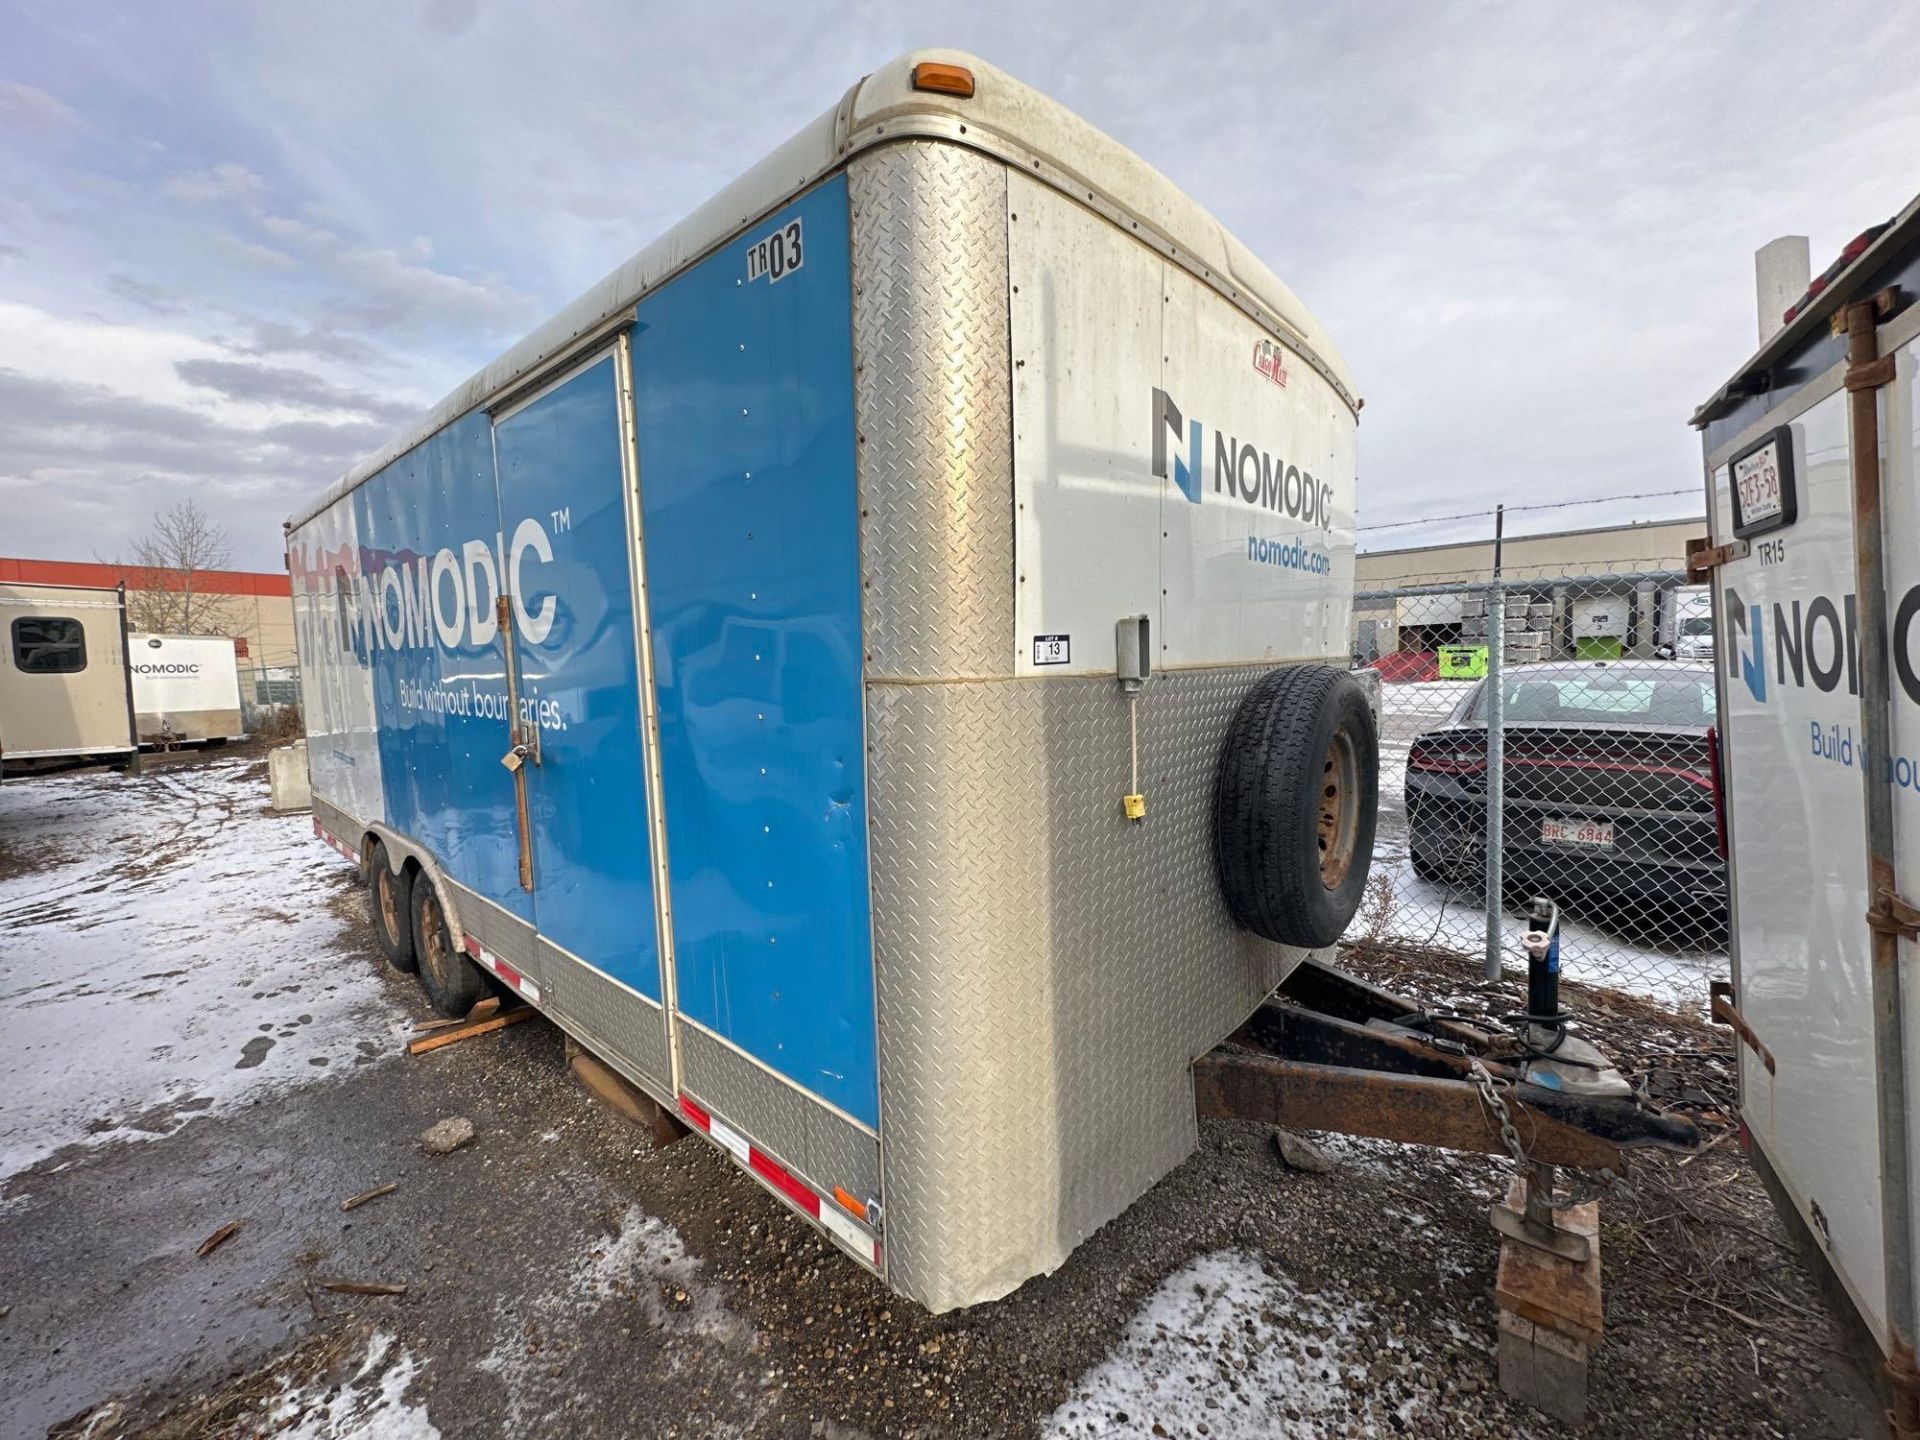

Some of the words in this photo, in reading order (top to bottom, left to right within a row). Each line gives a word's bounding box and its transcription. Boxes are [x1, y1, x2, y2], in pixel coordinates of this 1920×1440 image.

[747, 222, 802, 279] TR03
[1214, 429, 1332, 531] NOMODIC
[1248, 535, 1331, 577] nomodic.com
[1757, 538, 1785, 567] TR15
[360, 517, 557, 651] NOMODIC
[129, 664, 199, 674] NOMODIC
[1048, 642, 1060, 655] 13
[400, 679, 422, 710] Build
[425, 683, 471, 717] without
[1810, 721, 1853, 767] Build
